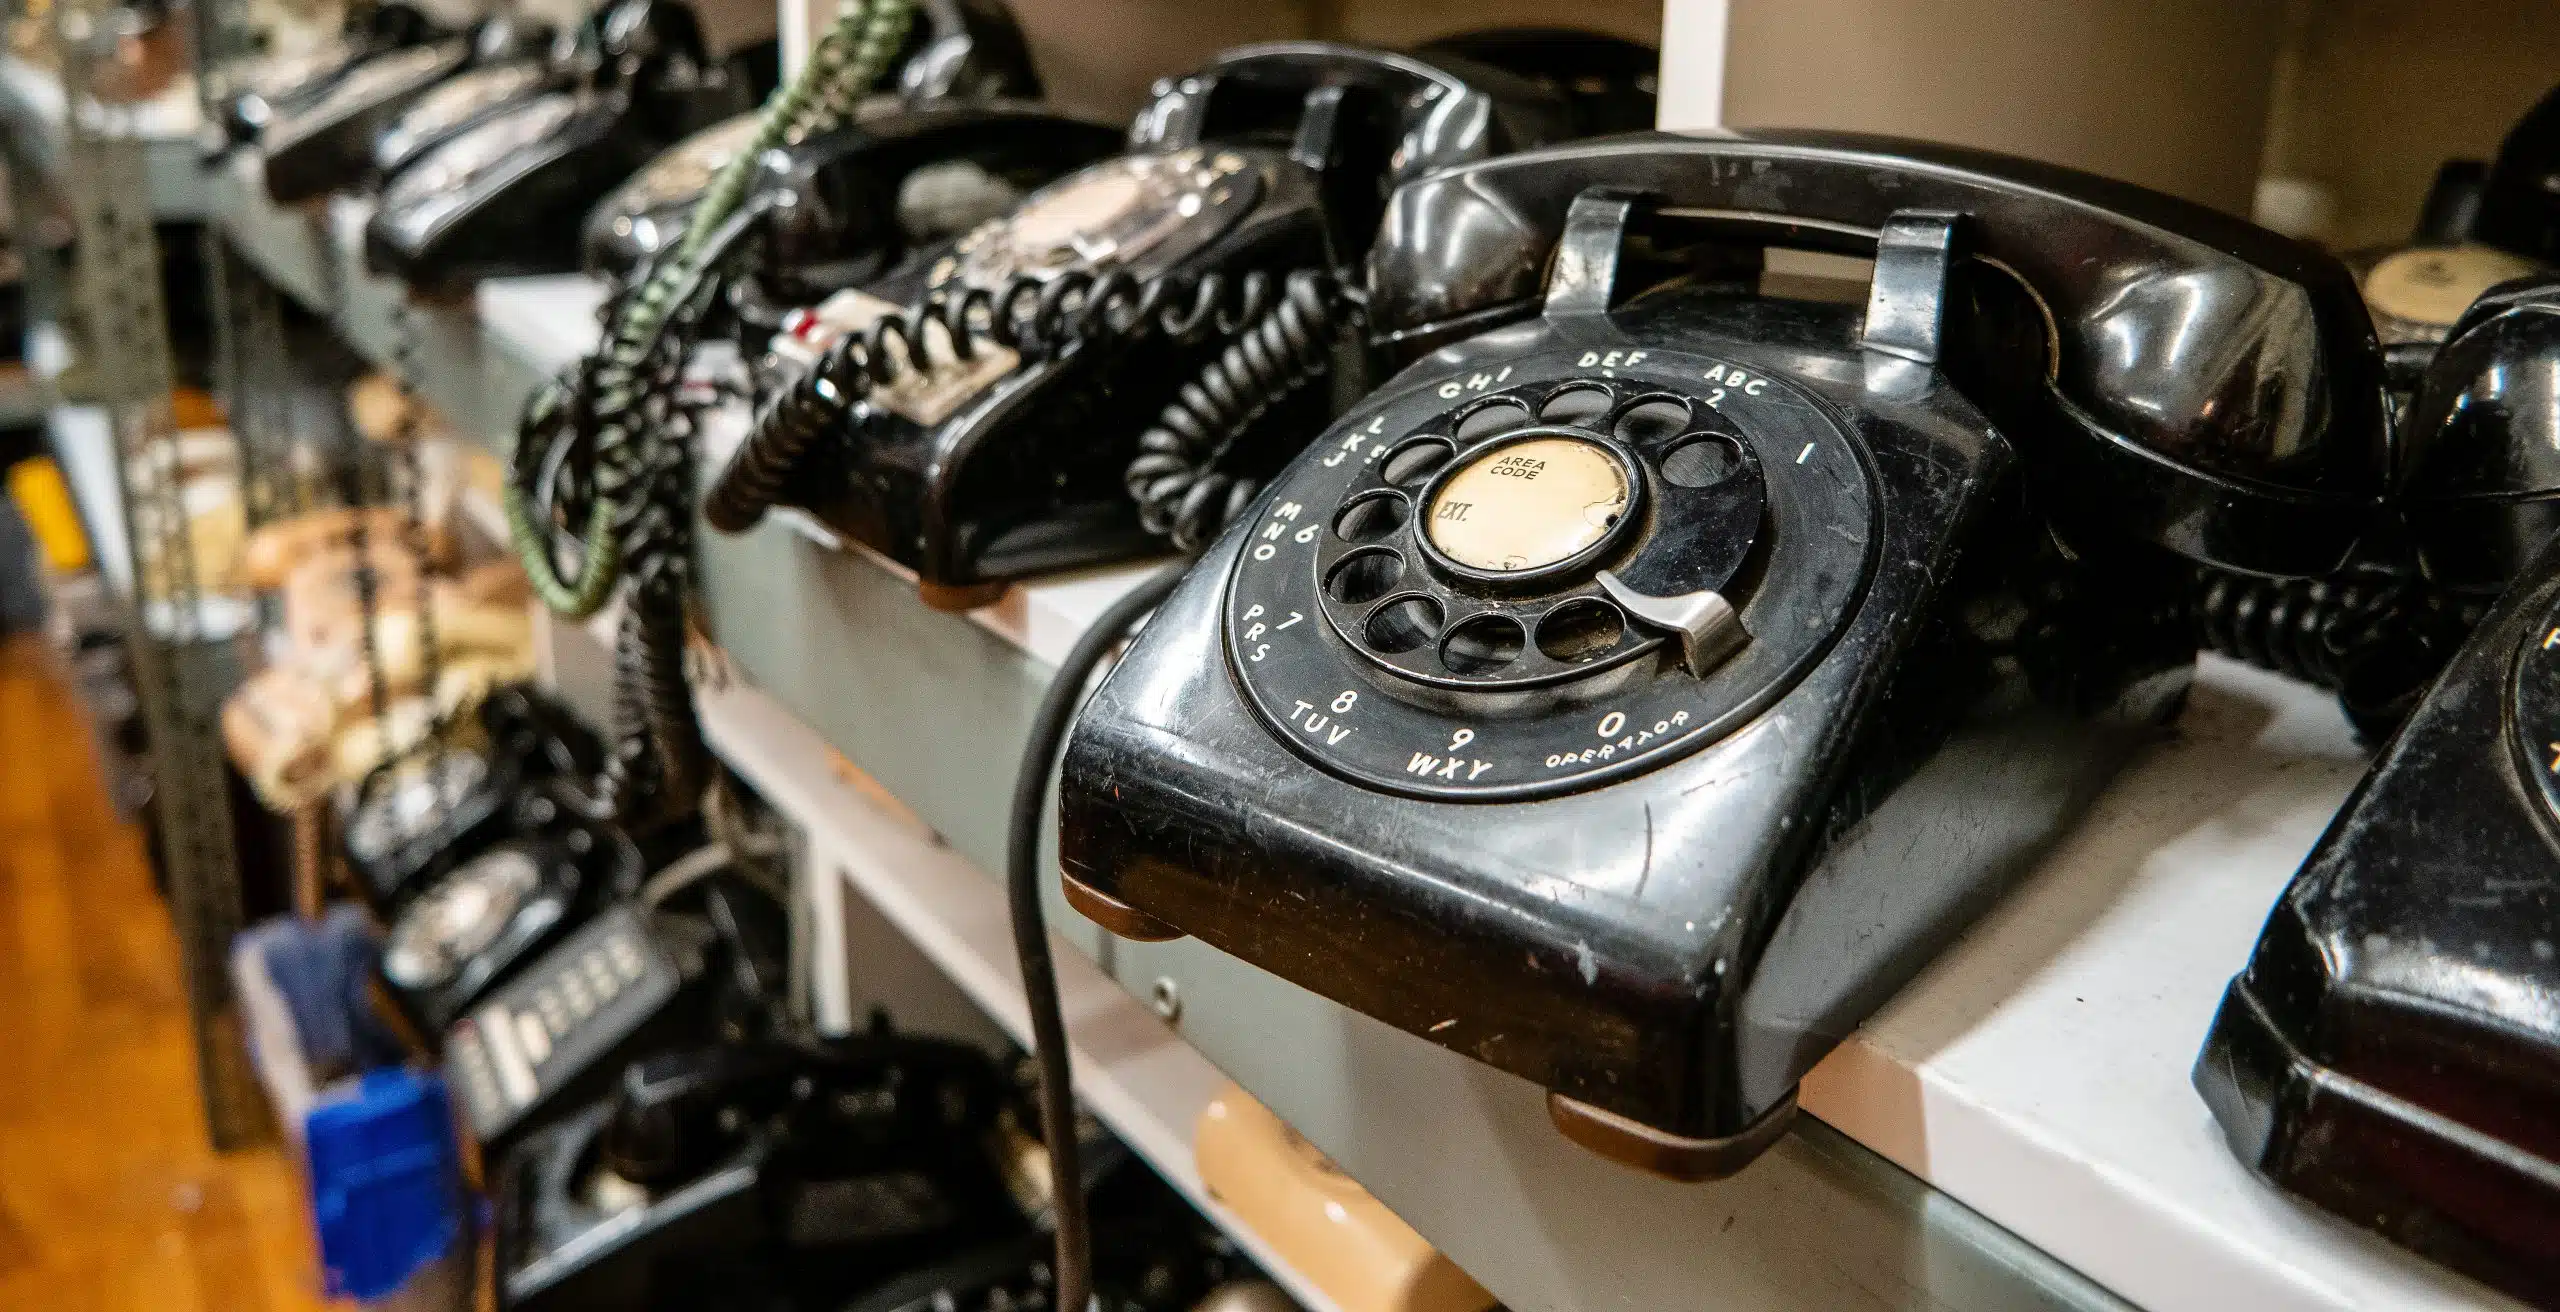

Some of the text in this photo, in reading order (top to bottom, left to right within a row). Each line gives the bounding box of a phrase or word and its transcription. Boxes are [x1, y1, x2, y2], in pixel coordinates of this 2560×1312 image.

[1577, 351, 1647, 368] DEF
[1703, 364, 1768, 395] ABC
[1705, 388, 1726, 408] 2
[1323, 416, 1384, 467] JKL
[1490, 466, 1539, 480] CODE
[1498, 456, 1546, 470] AREA
[1436, 501, 1473, 522] EXT.
[1254, 501, 1302, 561] MNO
[1295, 523, 1319, 543] 6
[1276, 611, 1303, 630] 7
[1242, 604, 1270, 662] PRS
[1330, 690, 1358, 713] 8
[1290, 700, 1351, 746] TUV
[1448, 728, 1475, 751] 9
[1545, 710, 1689, 768] OPERATOR
[1406, 751, 1493, 780] WXY
